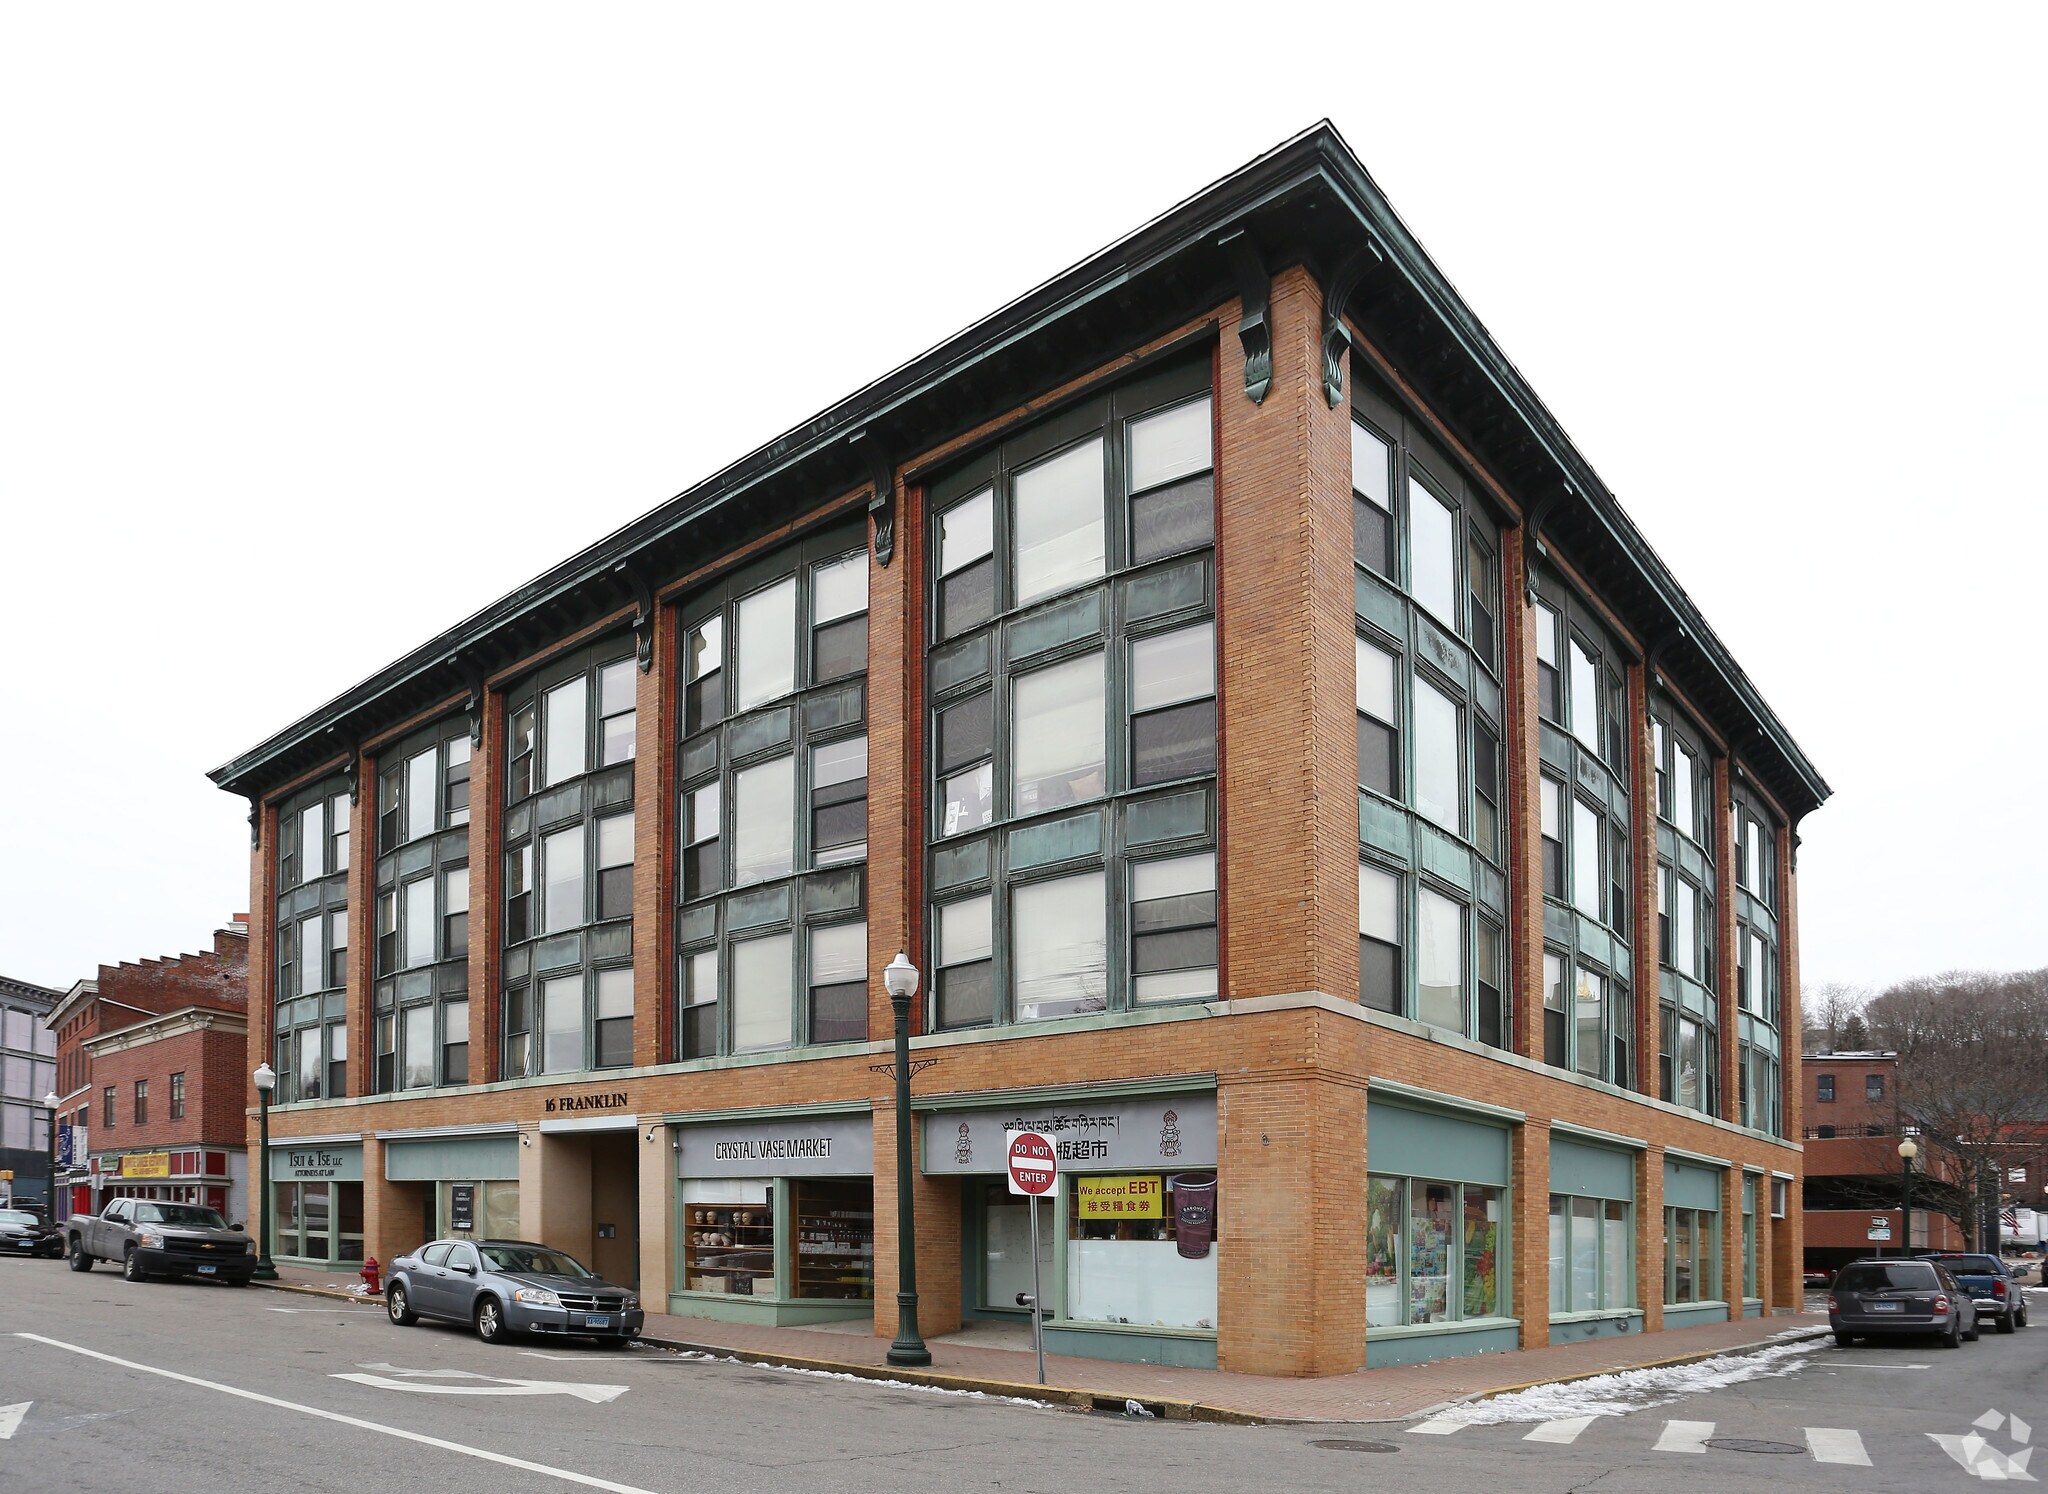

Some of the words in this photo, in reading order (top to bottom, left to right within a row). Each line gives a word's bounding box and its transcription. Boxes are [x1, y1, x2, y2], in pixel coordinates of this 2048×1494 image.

[545, 1098, 556, 1112] 16
[559, 1093, 628, 1111] FRANKLIN
[714, 1141, 756, 1161] CRYSTAL
[757, 1139, 785, 1160] VASE
[786, 1138, 832, 1159] MARKET
[1015, 1143, 1028, 1155] DO
[1032, 1145, 1049, 1157] NOT
[307, 1155, 314, 1167] &
[332, 1157, 343, 1166] LLC
[295, 1169, 319, 1177] ATTORNEYS
[1019, 1171, 1047, 1183] ENTER
[1079, 1186, 1093, 1195] We
[1095, 1185, 1126, 1197] accept
[1129, 1181, 1159, 1195] EBT
